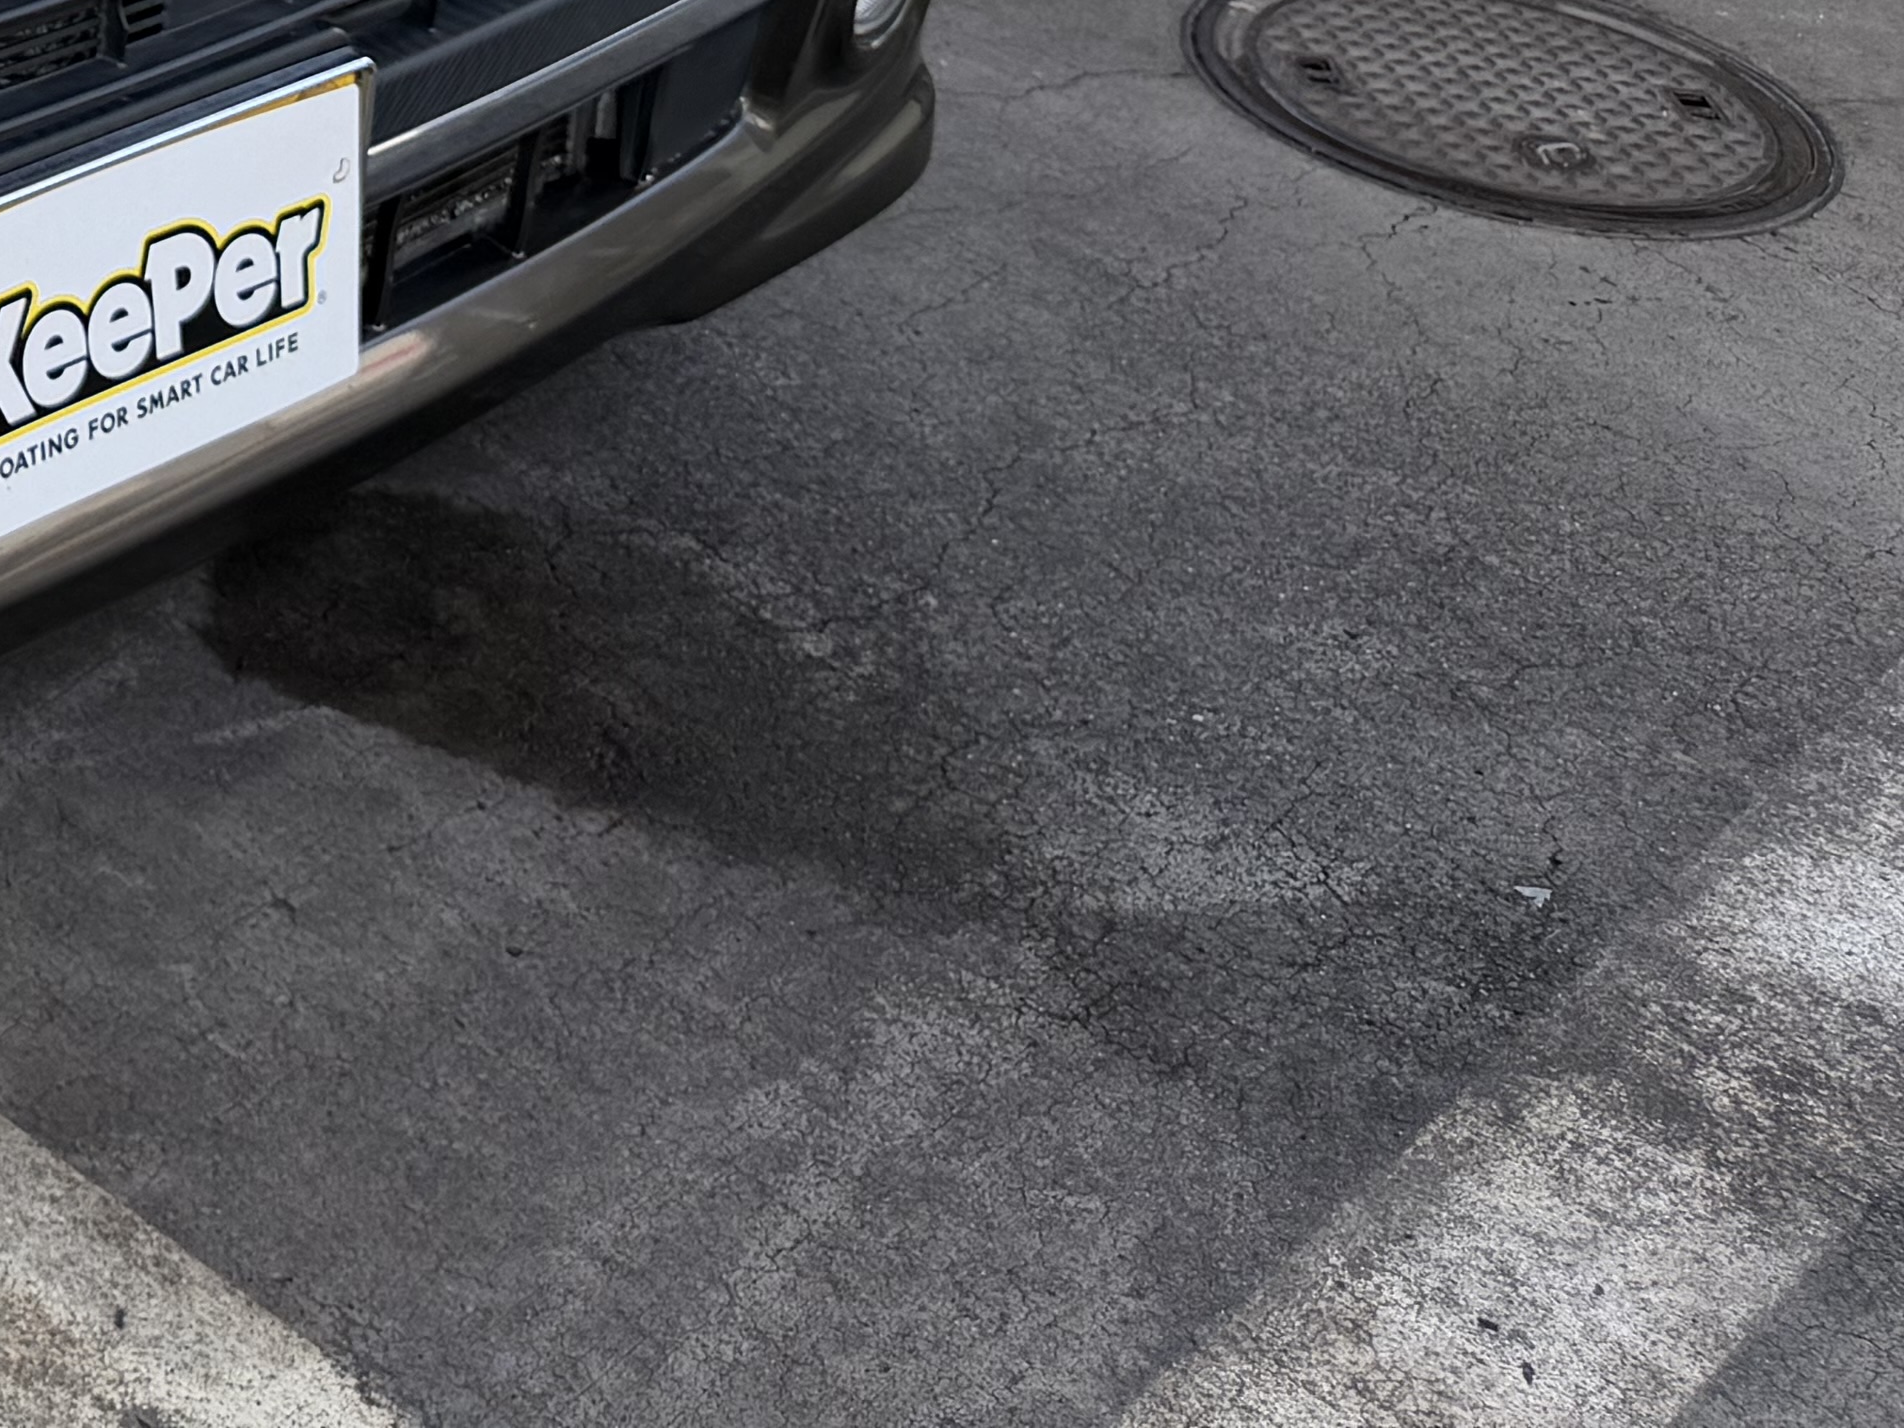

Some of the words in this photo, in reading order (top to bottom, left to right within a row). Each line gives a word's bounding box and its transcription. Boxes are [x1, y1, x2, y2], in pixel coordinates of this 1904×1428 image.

[87, 406, 130, 442] FOR
[137, 374, 203, 420] SMART
[210, 355, 249, 387] CAR
[256, 332, 300, 369] LIFE
